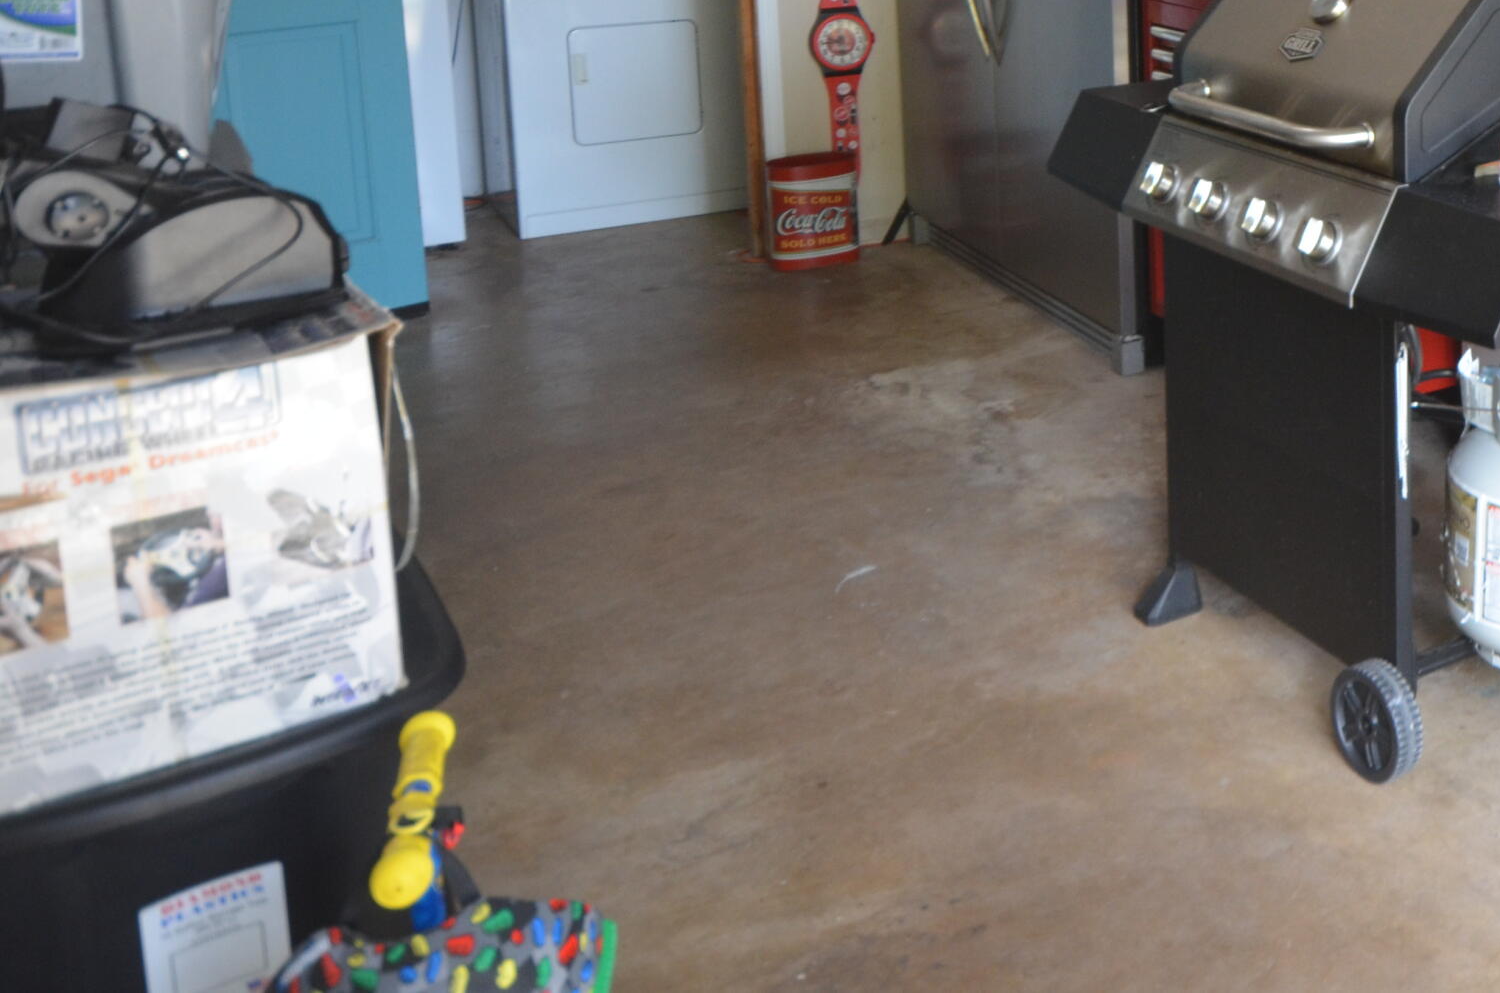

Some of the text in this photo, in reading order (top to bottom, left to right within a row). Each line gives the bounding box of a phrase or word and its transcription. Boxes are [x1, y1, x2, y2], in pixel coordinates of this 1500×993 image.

[783, 195, 843, 205] ICE COLD
[780, 238, 816, 249] SOLD
